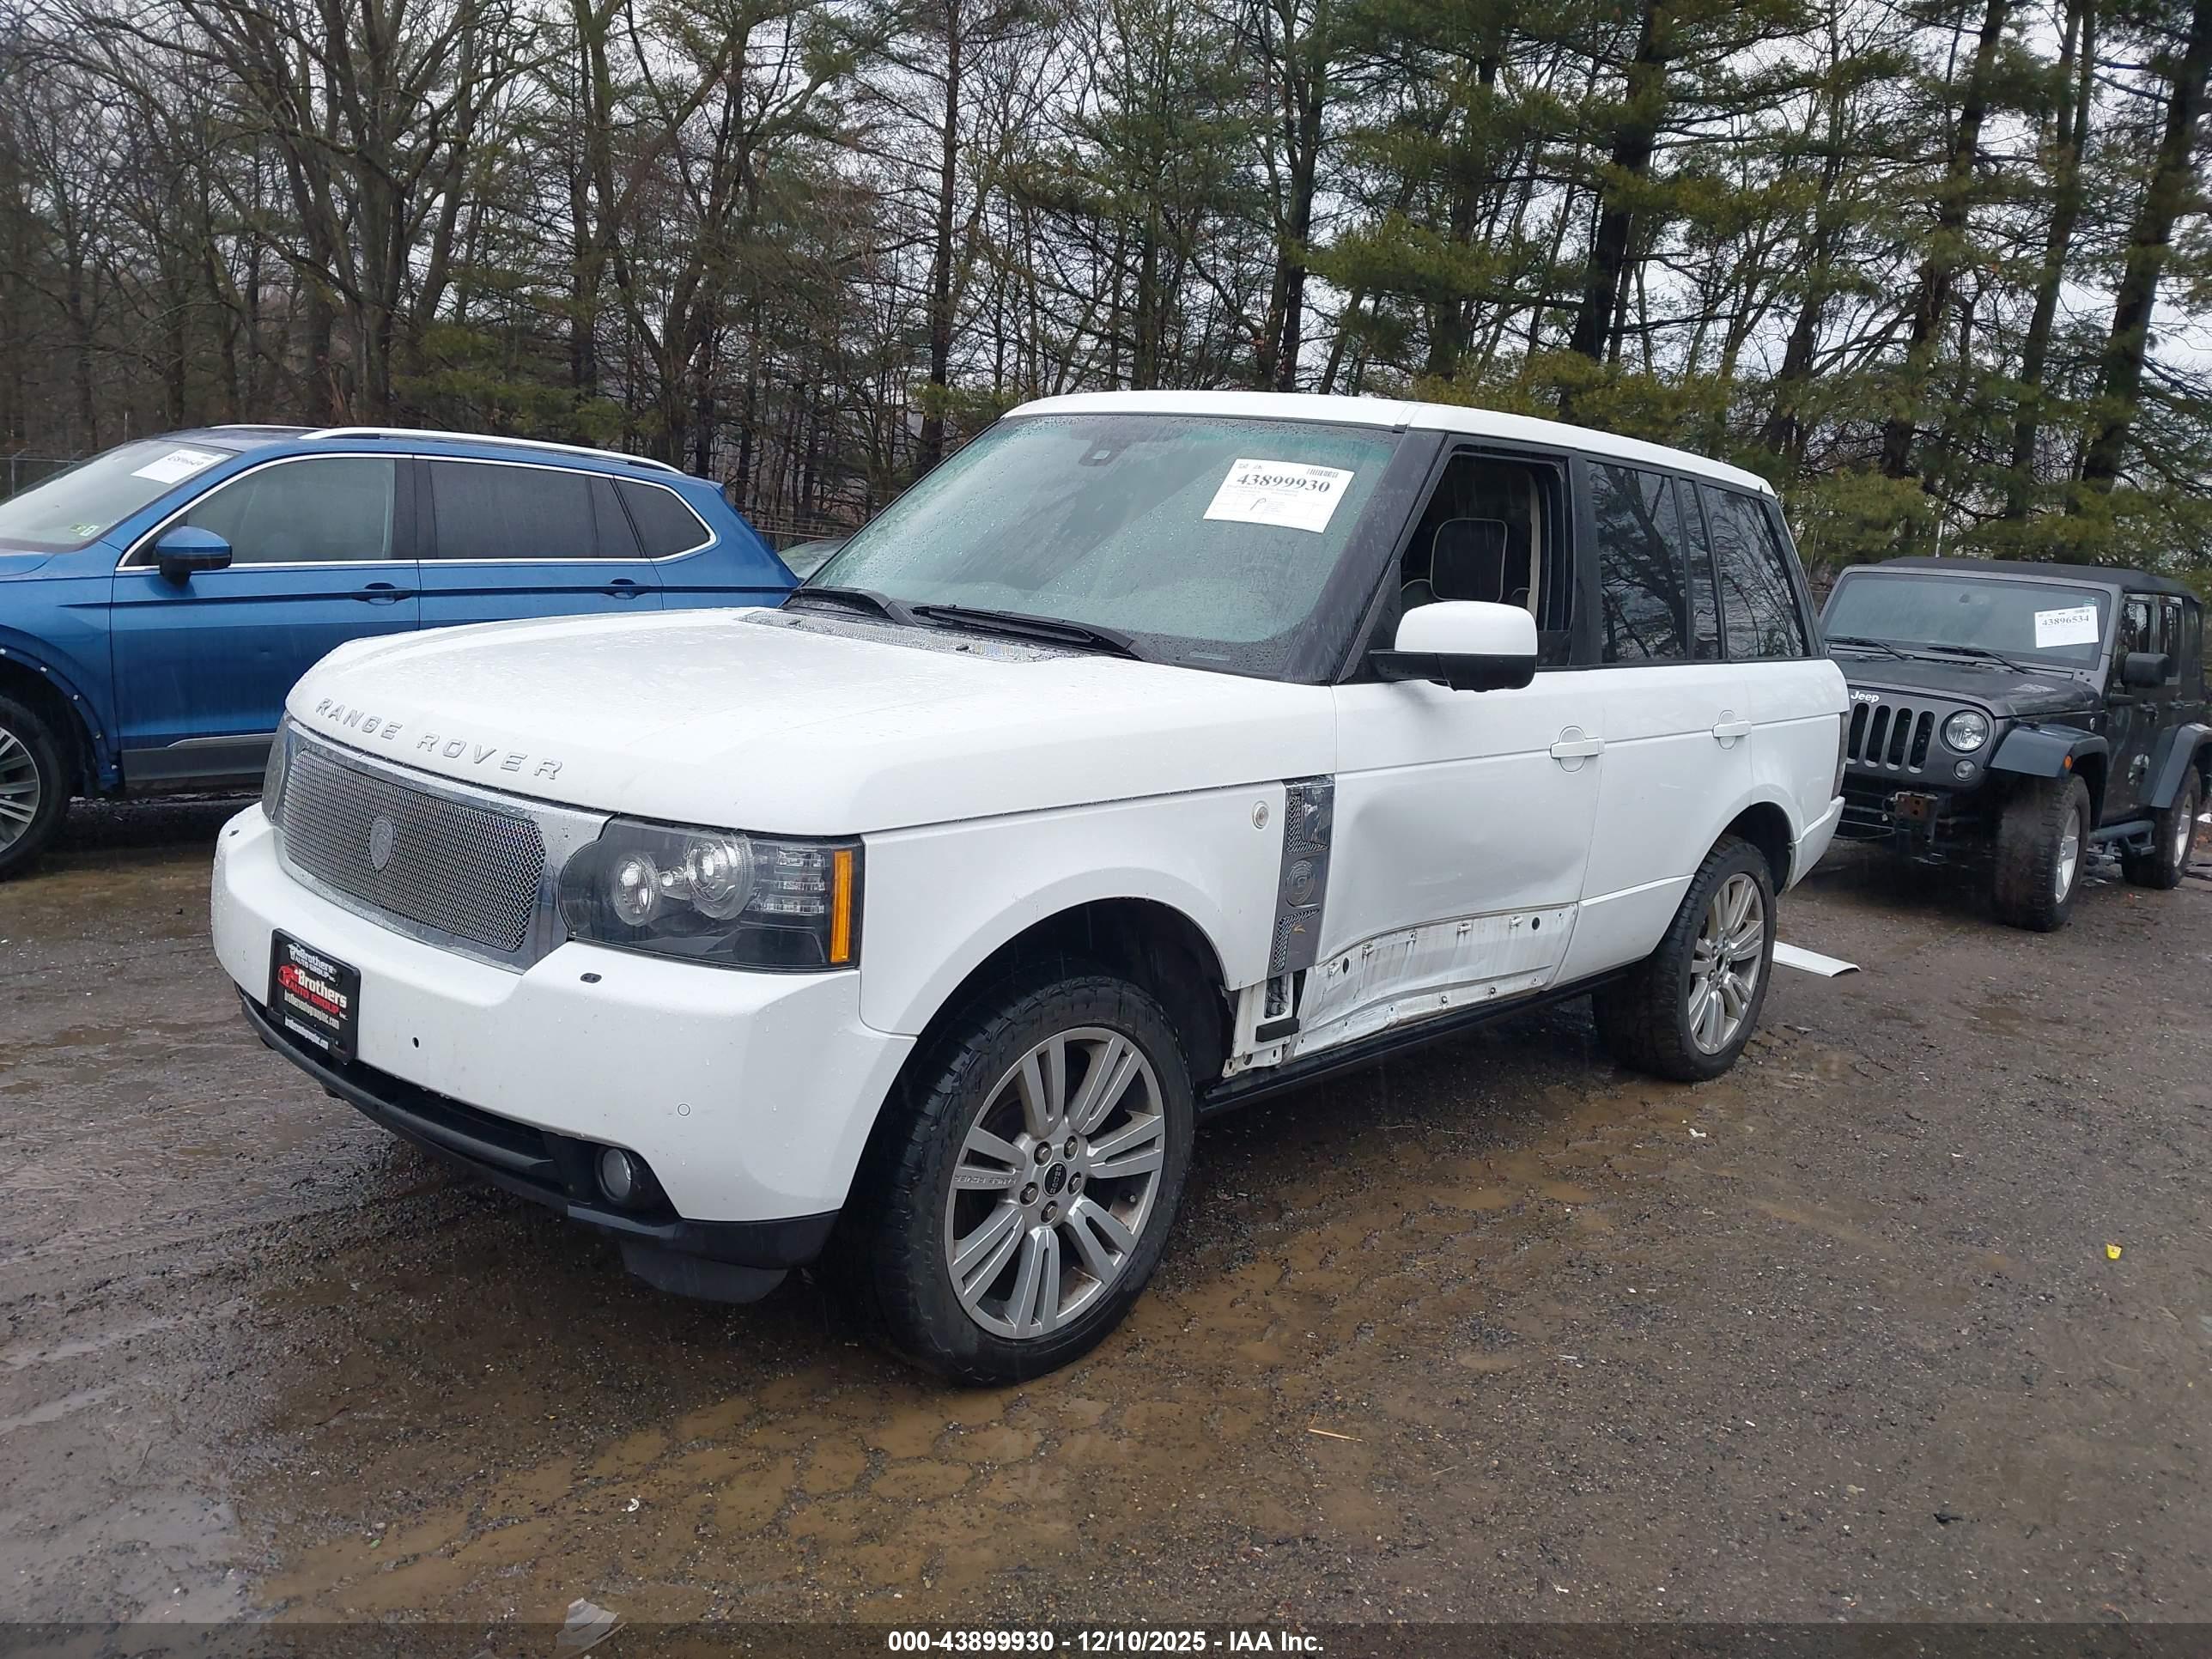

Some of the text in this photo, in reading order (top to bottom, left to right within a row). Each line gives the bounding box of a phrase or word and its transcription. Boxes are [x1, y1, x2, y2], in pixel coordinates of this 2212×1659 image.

[1237, 473, 1331, 493] 43899930
[2042, 615, 2089, 626] 43896534
[1850, 690, 1880, 703] Jeep
[315, 697, 563, 780] RANGE ROVER
[295, 957, 309, 969] AUTO
[309, 963, 330, 978] GROUP
[300, 949, 333, 974] Brothers
[289, 981, 309, 999] AUTO
[310, 994, 340, 1014] GROUP
[298, 969, 347, 1009] Brothers
